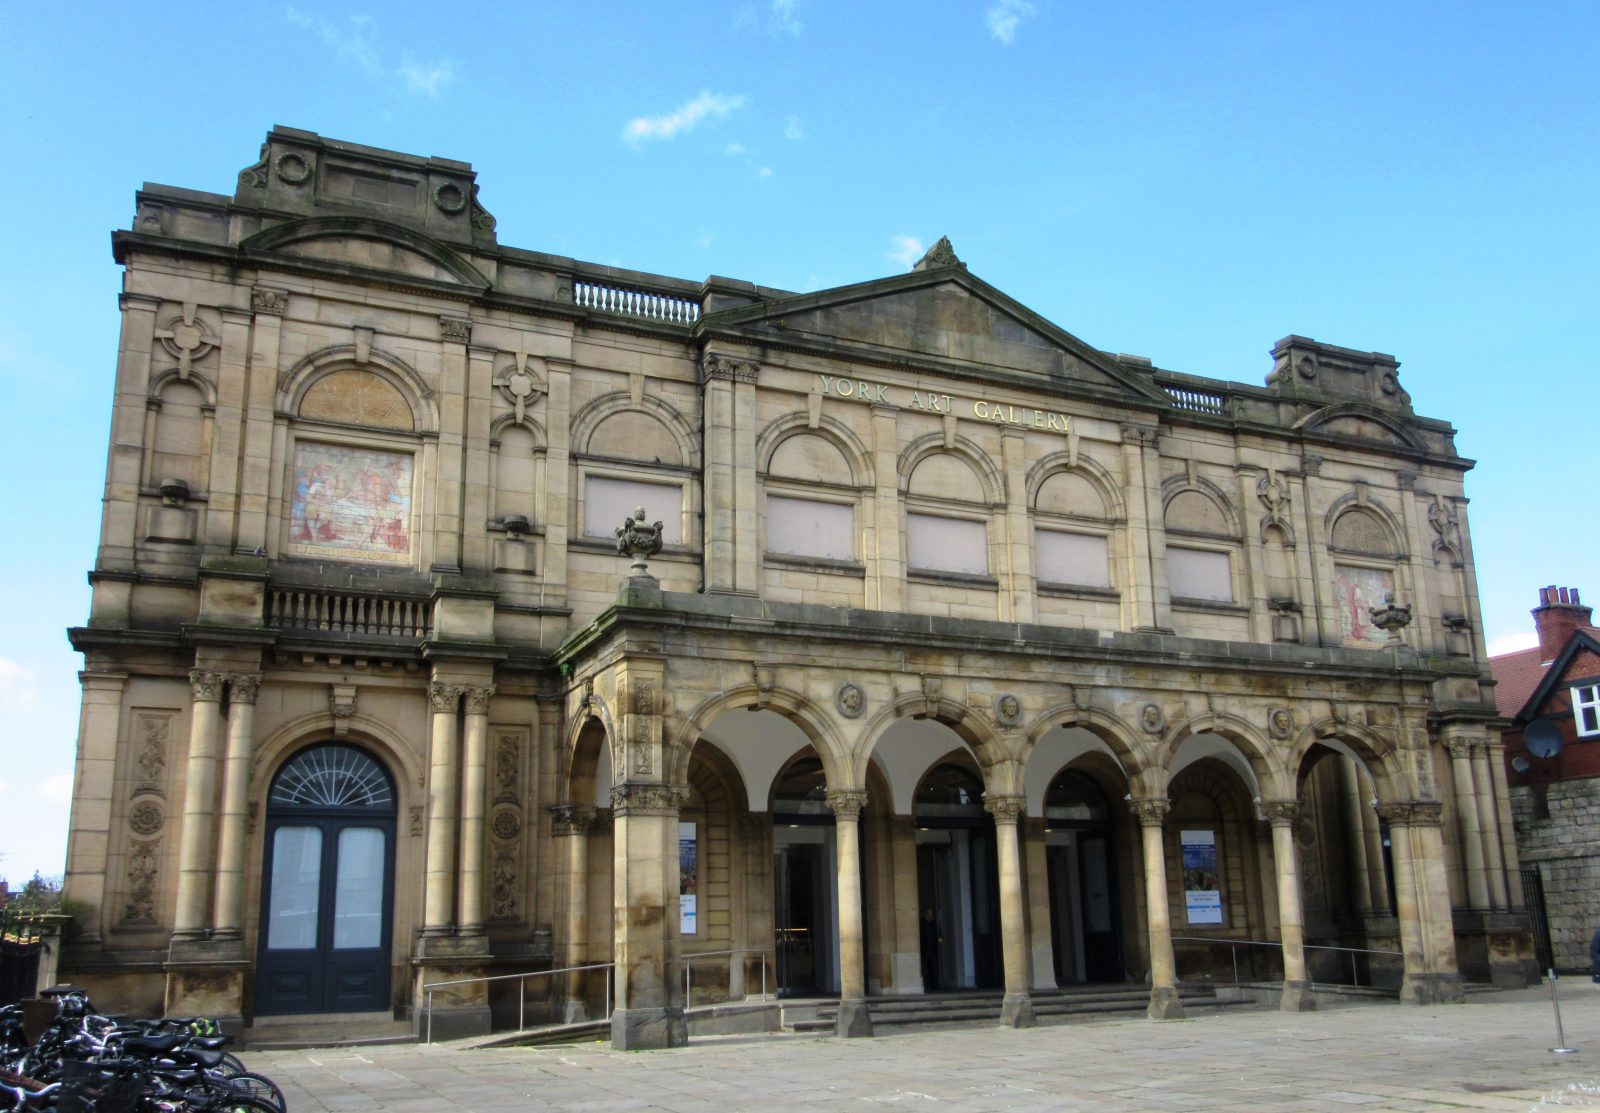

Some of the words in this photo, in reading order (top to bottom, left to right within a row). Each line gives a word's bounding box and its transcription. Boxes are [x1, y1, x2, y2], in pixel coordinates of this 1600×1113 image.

[820, 375, 889, 403] YORK
[910, 391, 954, 413] ART
[974, 401, 1072, 431] GALLERY
